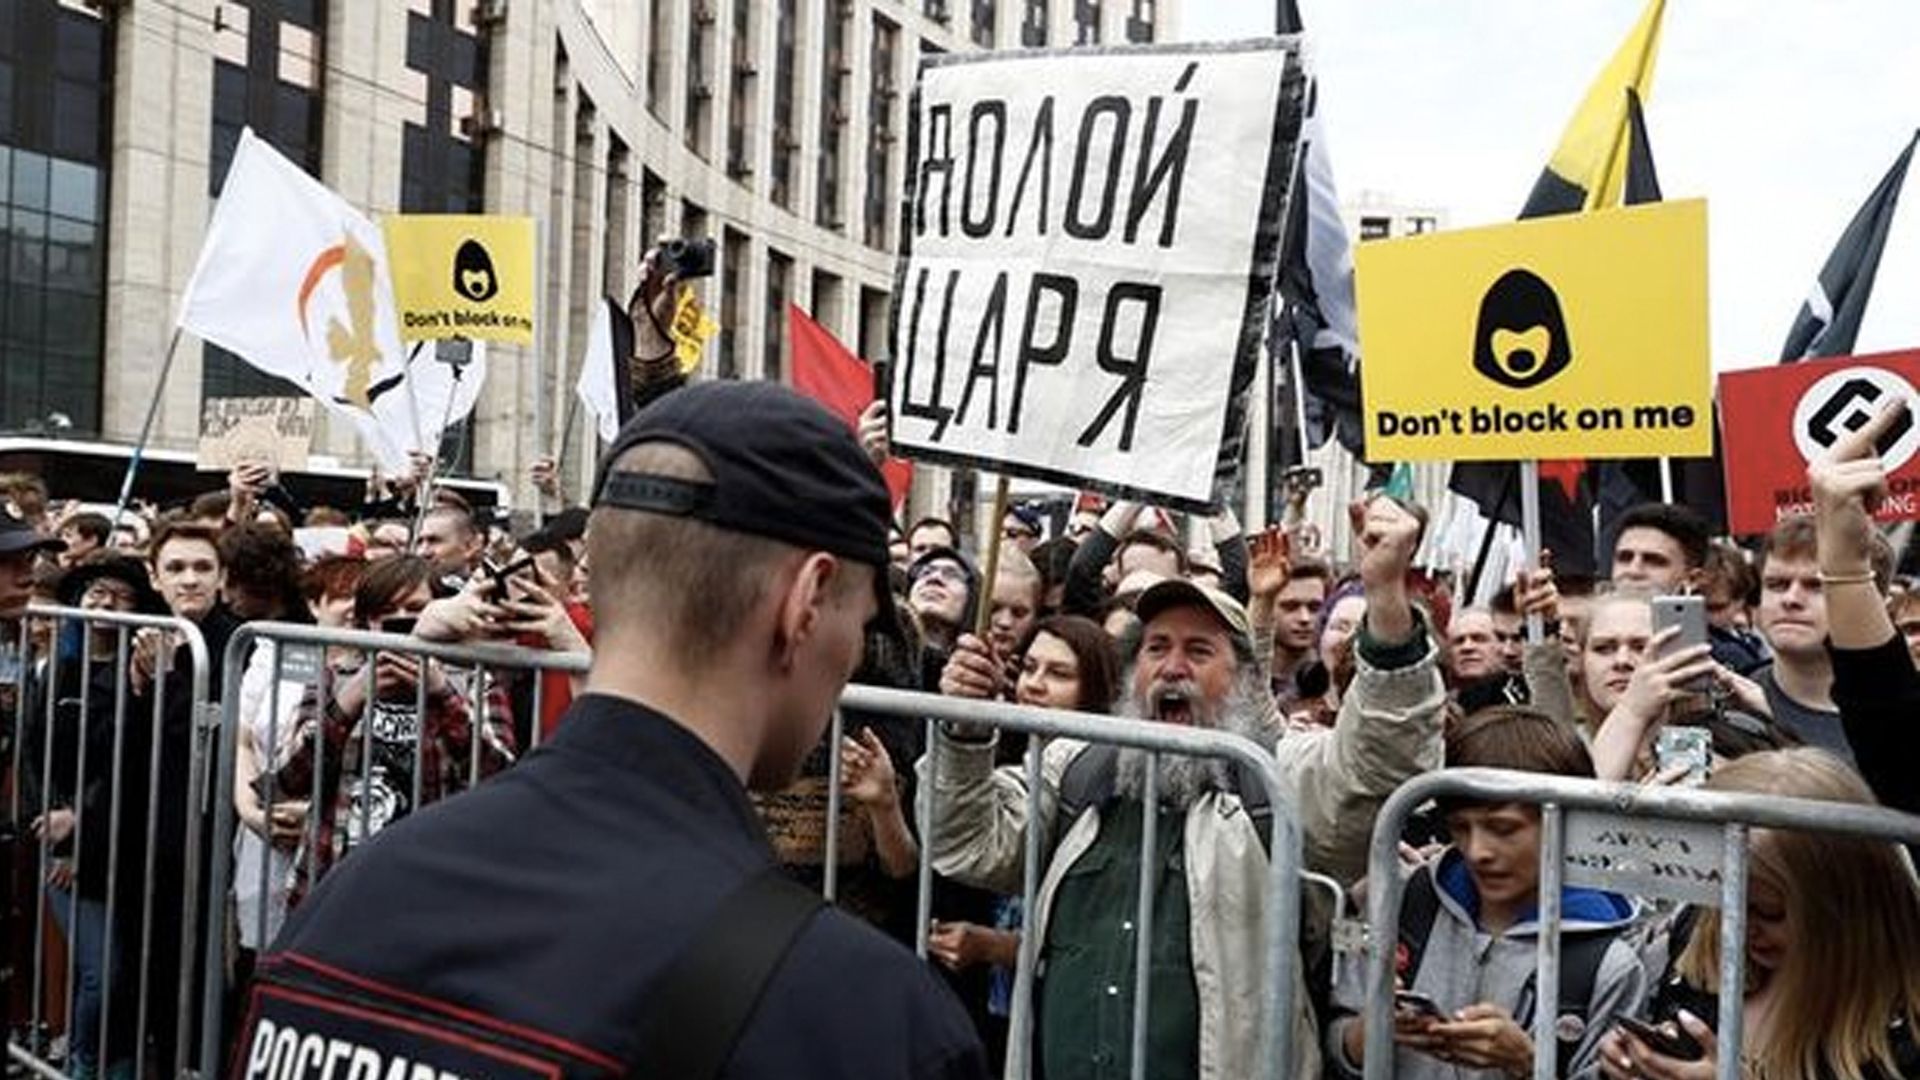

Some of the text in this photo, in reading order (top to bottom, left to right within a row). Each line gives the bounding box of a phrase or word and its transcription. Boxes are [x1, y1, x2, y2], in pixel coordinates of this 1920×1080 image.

[915, 61, 1200, 248] ДОЛОЙ
[403, 311, 450, 327] Don't
[453, 309, 500, 327] block
[899, 267, 1163, 453] ЦАРЯ
[1377, 403, 1695, 436] Don't block on me
